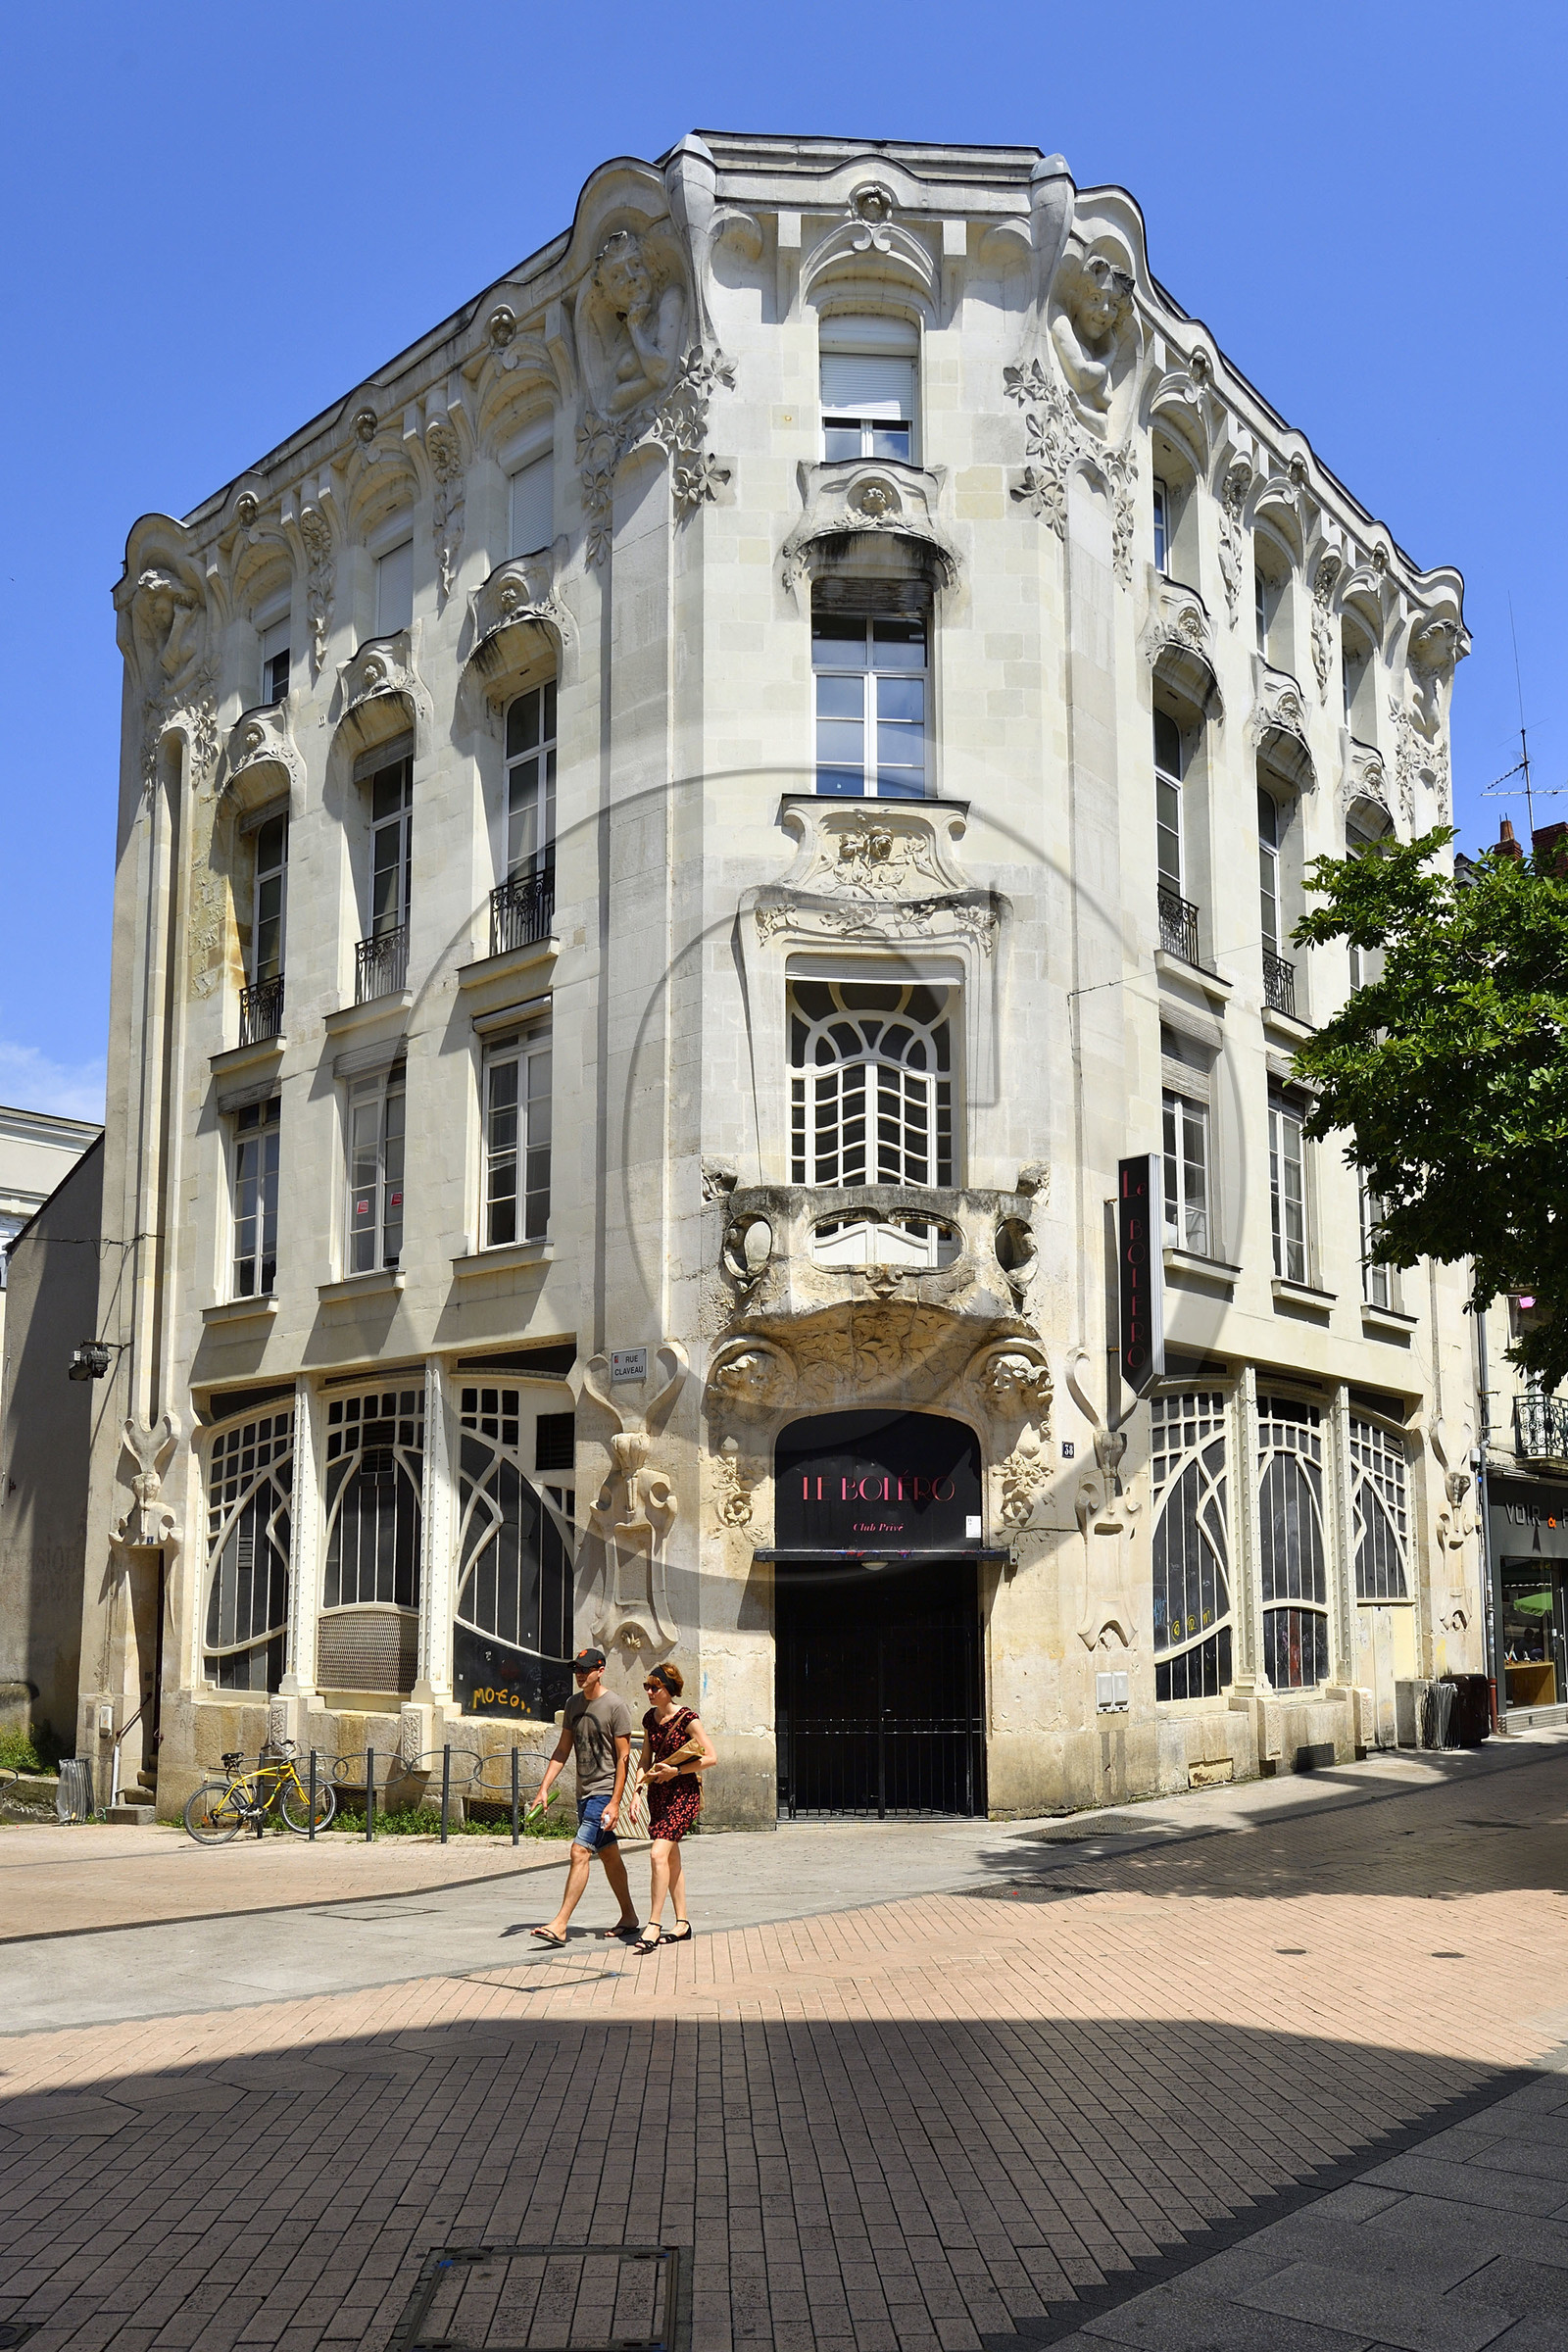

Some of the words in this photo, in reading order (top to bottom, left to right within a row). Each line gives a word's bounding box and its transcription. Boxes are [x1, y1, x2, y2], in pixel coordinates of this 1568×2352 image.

[1122, 1170, 1146, 1199] Le
[1127, 1218, 1146, 1368] BOLERO
[614, 1366, 644, 1376] CLAVEAU
[1064, 1444, 1074, 1456] 38
[803, 1476, 831, 1501] LE
[842, 1470, 956, 1501] BOLÉRO
[1505, 1502, 1541, 1526] VOIR
[853, 1522, 876, 1533] Club
[878, 1522, 905, 1533] Privé
